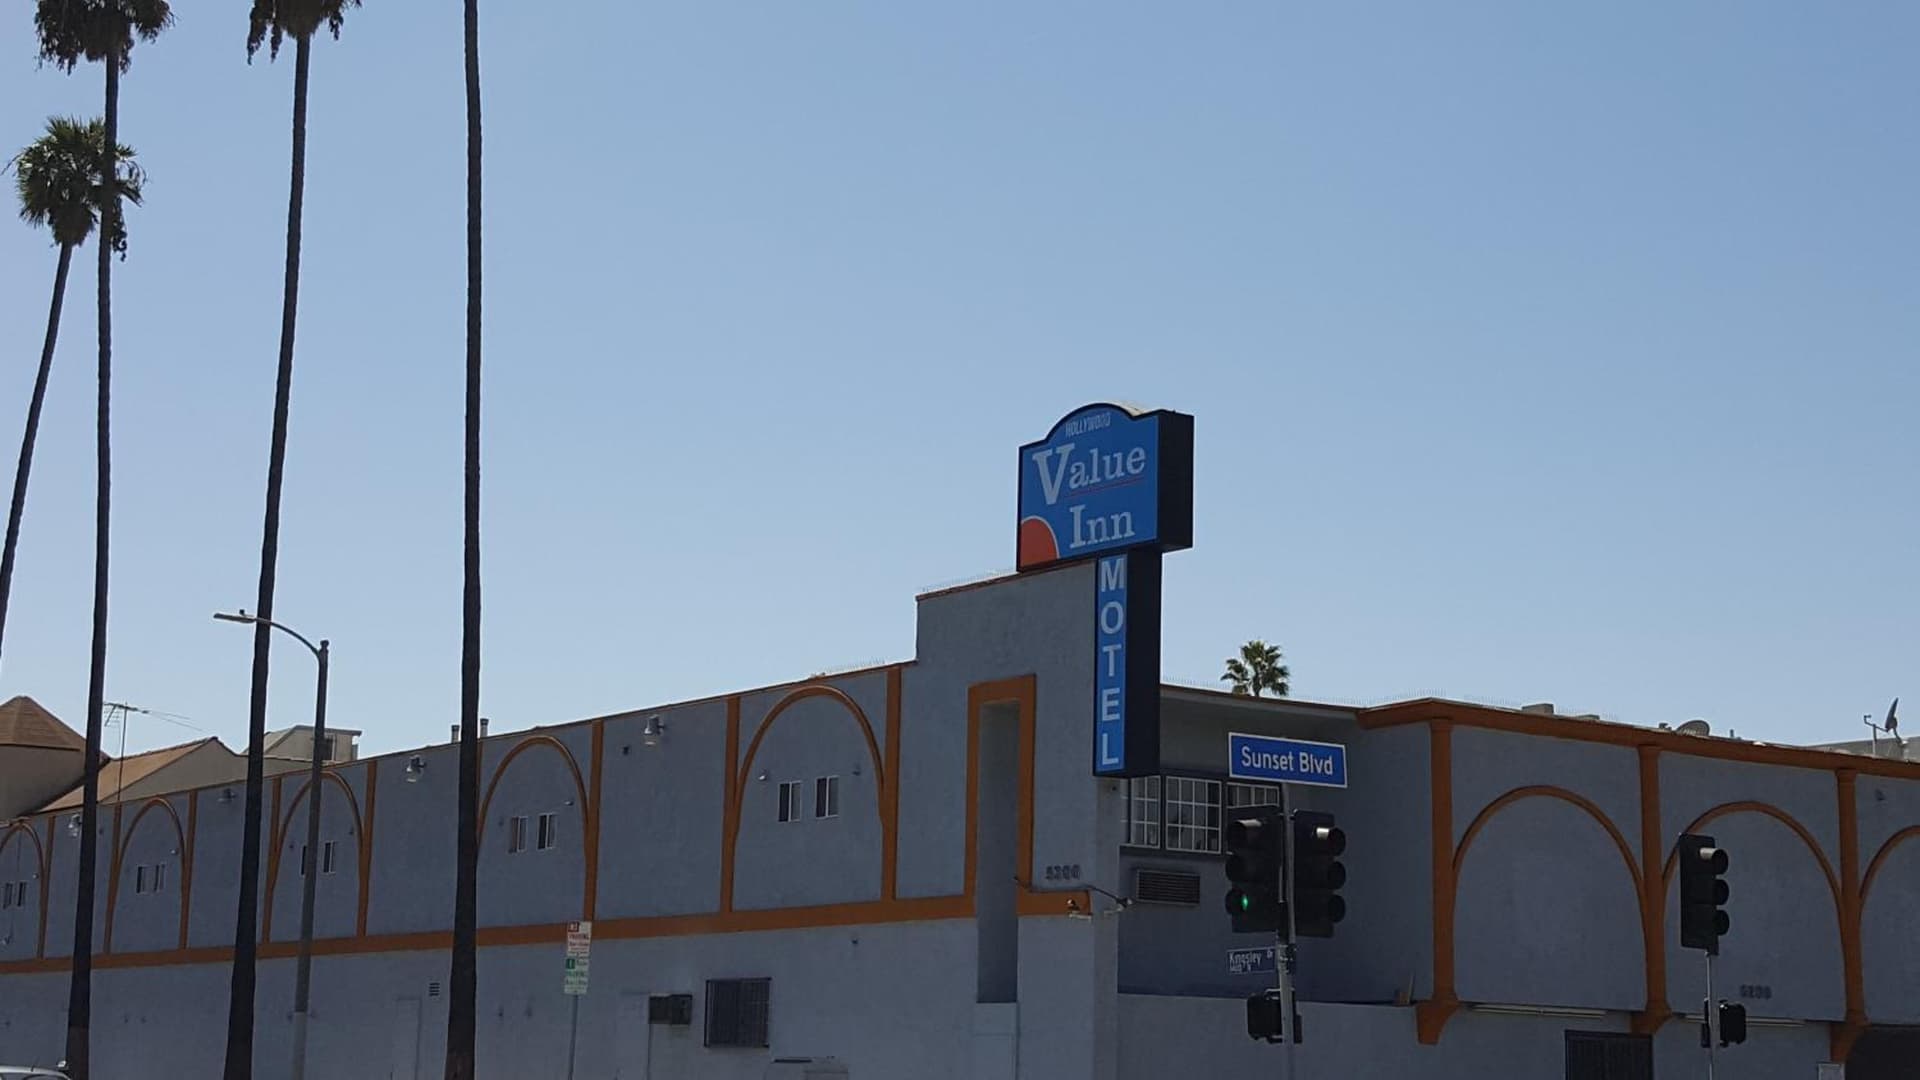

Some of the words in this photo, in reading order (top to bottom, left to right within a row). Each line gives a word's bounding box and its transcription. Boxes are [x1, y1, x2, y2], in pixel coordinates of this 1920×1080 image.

[1065, 412, 1112, 437] HOLLYWOOD
[1032, 442, 1146, 505] Value
[1069, 504, 1136, 549] Inn
[1100, 557, 1125, 766] MOTEL
[1241, 745, 1294, 772] Sunset
[1299, 751, 1333, 776] Blvd
